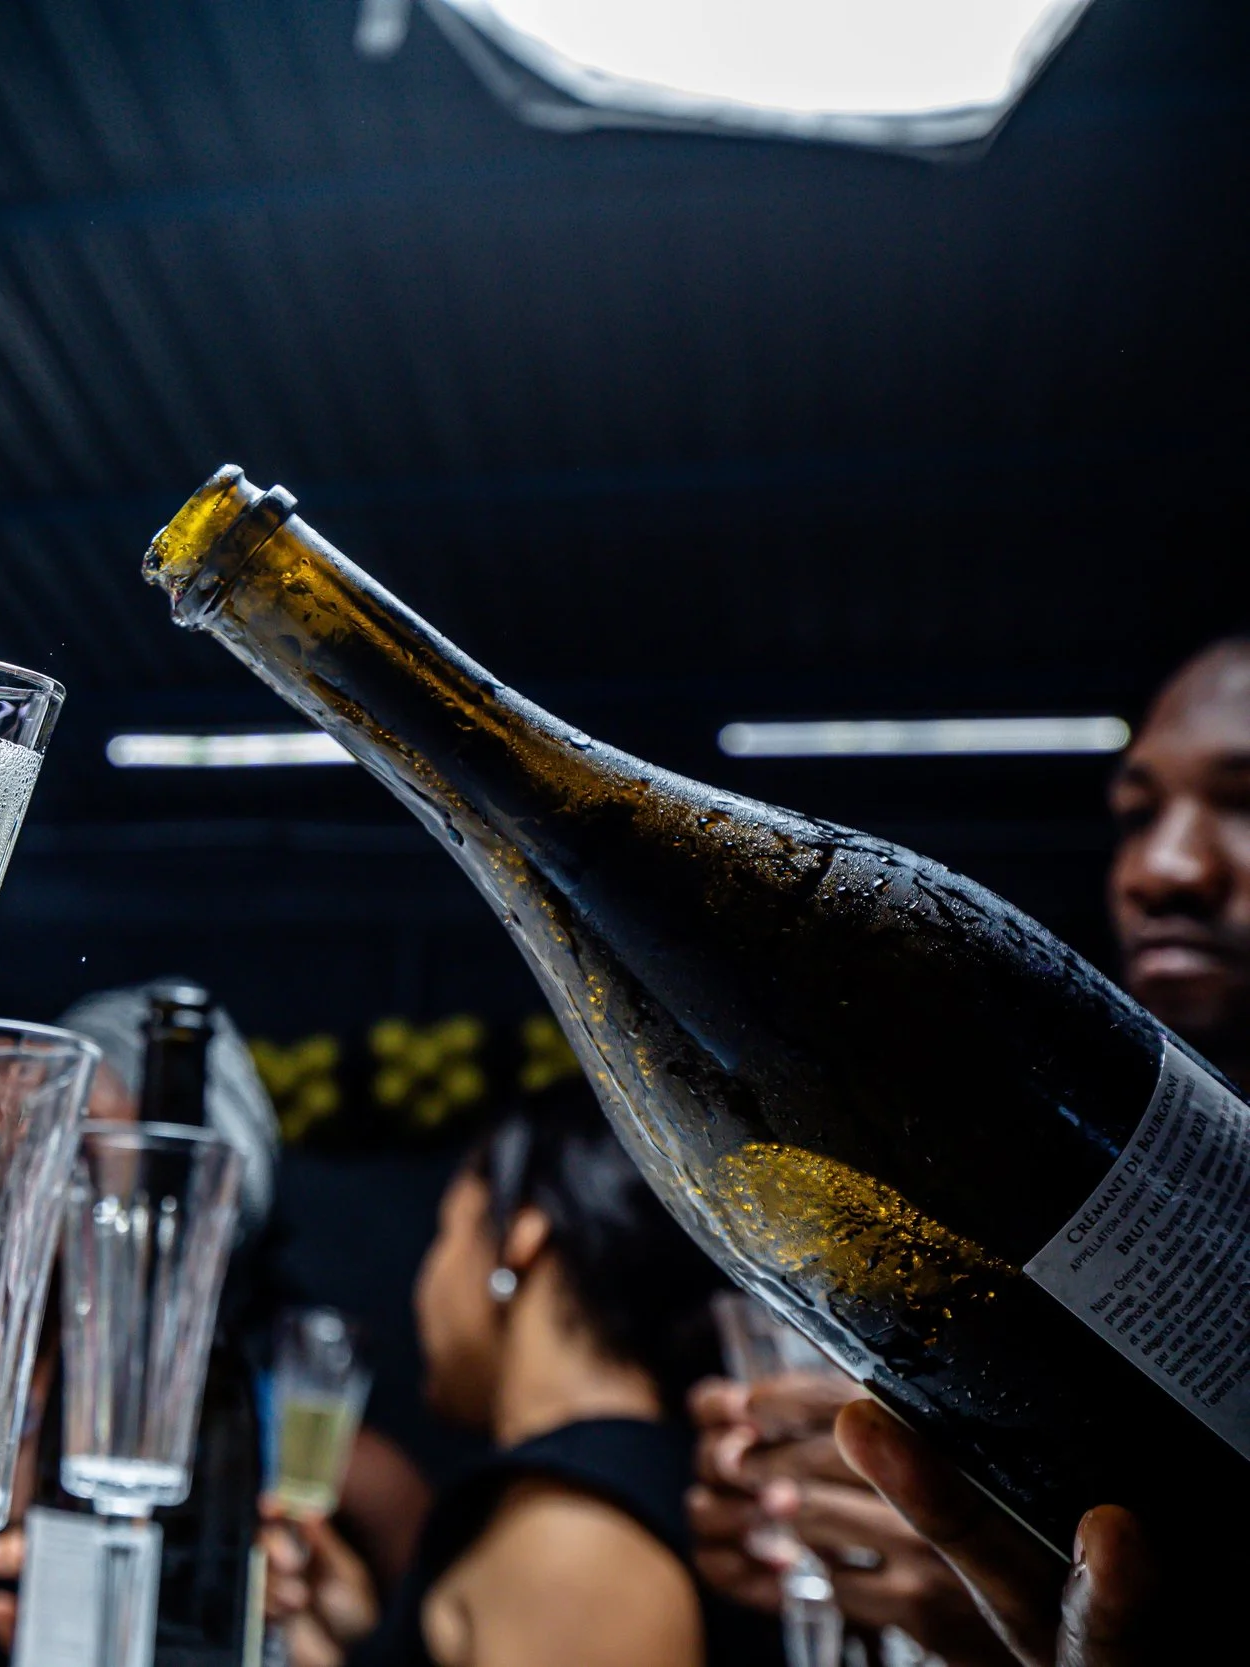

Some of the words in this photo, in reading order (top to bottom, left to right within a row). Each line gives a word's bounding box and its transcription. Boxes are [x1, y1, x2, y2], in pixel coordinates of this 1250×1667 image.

[1067, 1173, 1128, 1244] CRÉMANT
[1123, 1153, 1144, 1175] DE
[1136, 1072, 1180, 1153] BOURGOGNE
[1116, 1215, 1151, 1256] BRUT
[1188, 1112, 1212, 1145] 2020
[1070, 1217, 1122, 1272] APPELLATION
